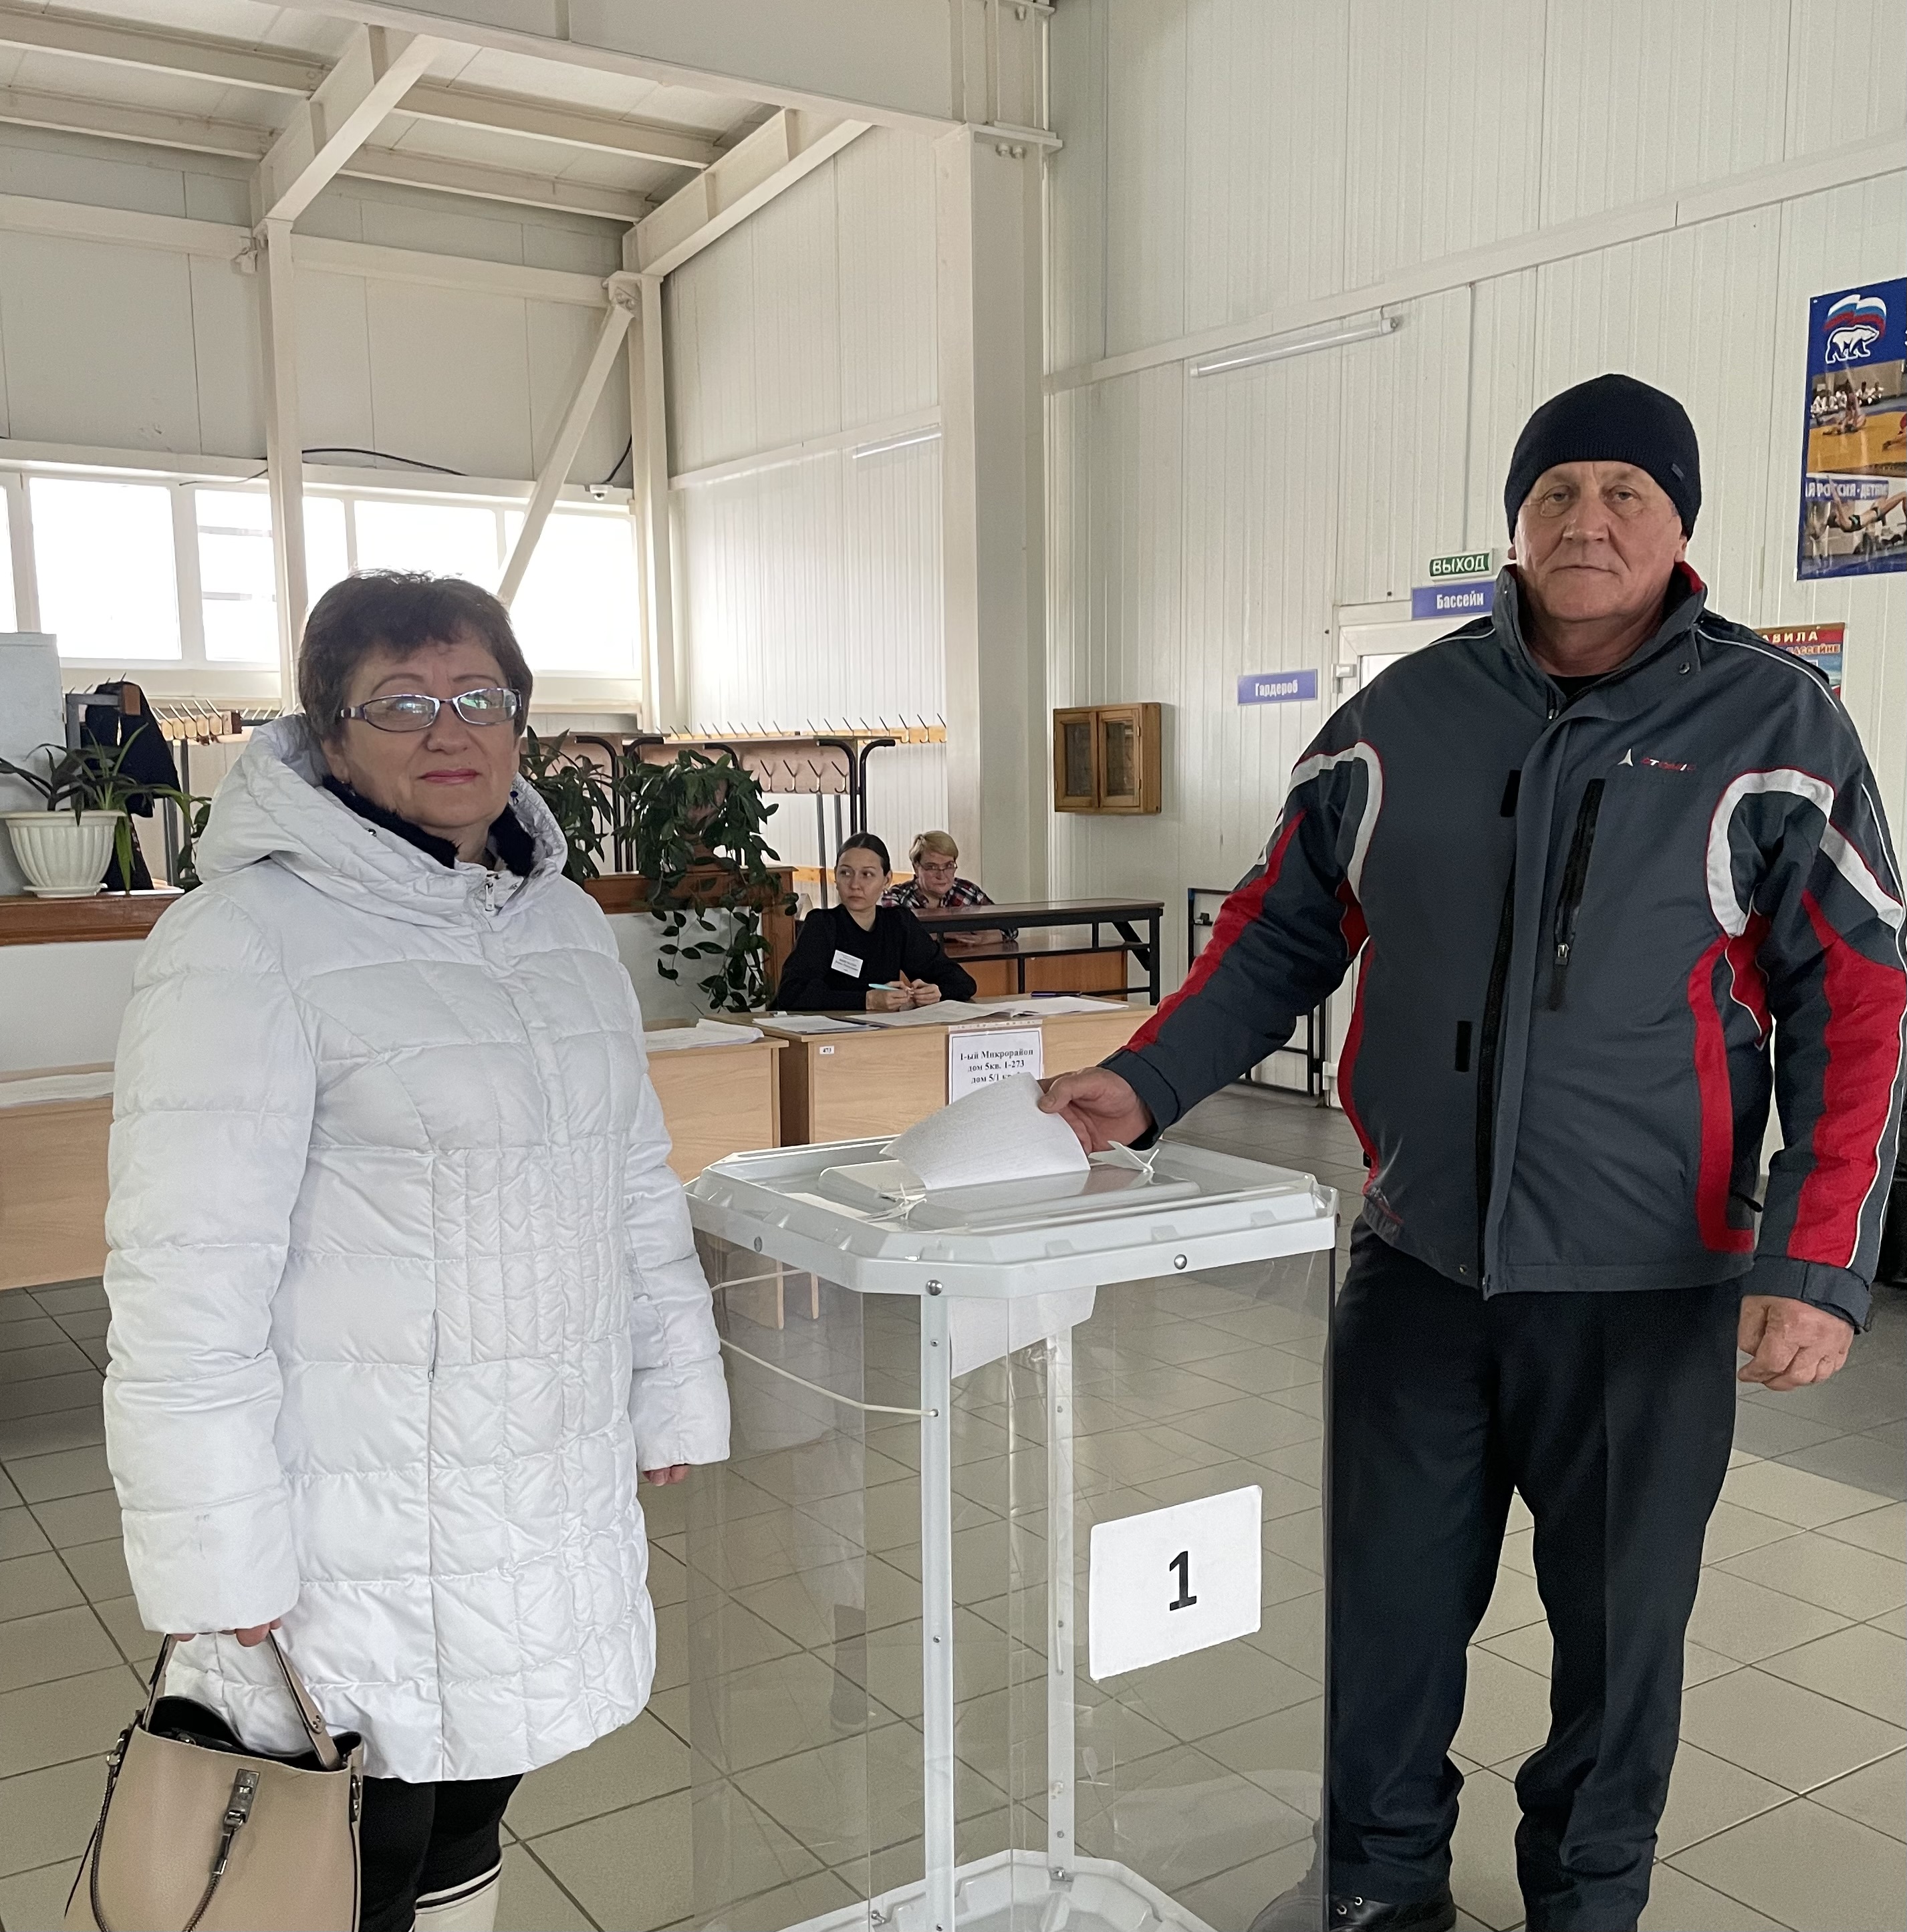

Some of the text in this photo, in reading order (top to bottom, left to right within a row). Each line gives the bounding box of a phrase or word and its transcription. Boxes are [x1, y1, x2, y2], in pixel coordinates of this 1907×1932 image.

[1817, 482, 1856, 497] РОСИЯ
[1432, 555, 1485, 575] ВЫХОД
[1436, 590, 1484, 609] Бассейн
[1255, 679, 1298, 697] Гардероб
[981, 1049, 1033, 1059] Микрорайон
[1005, 1059, 1025, 1069] 1-273
[1169, 1550, 1197, 1611] 1
